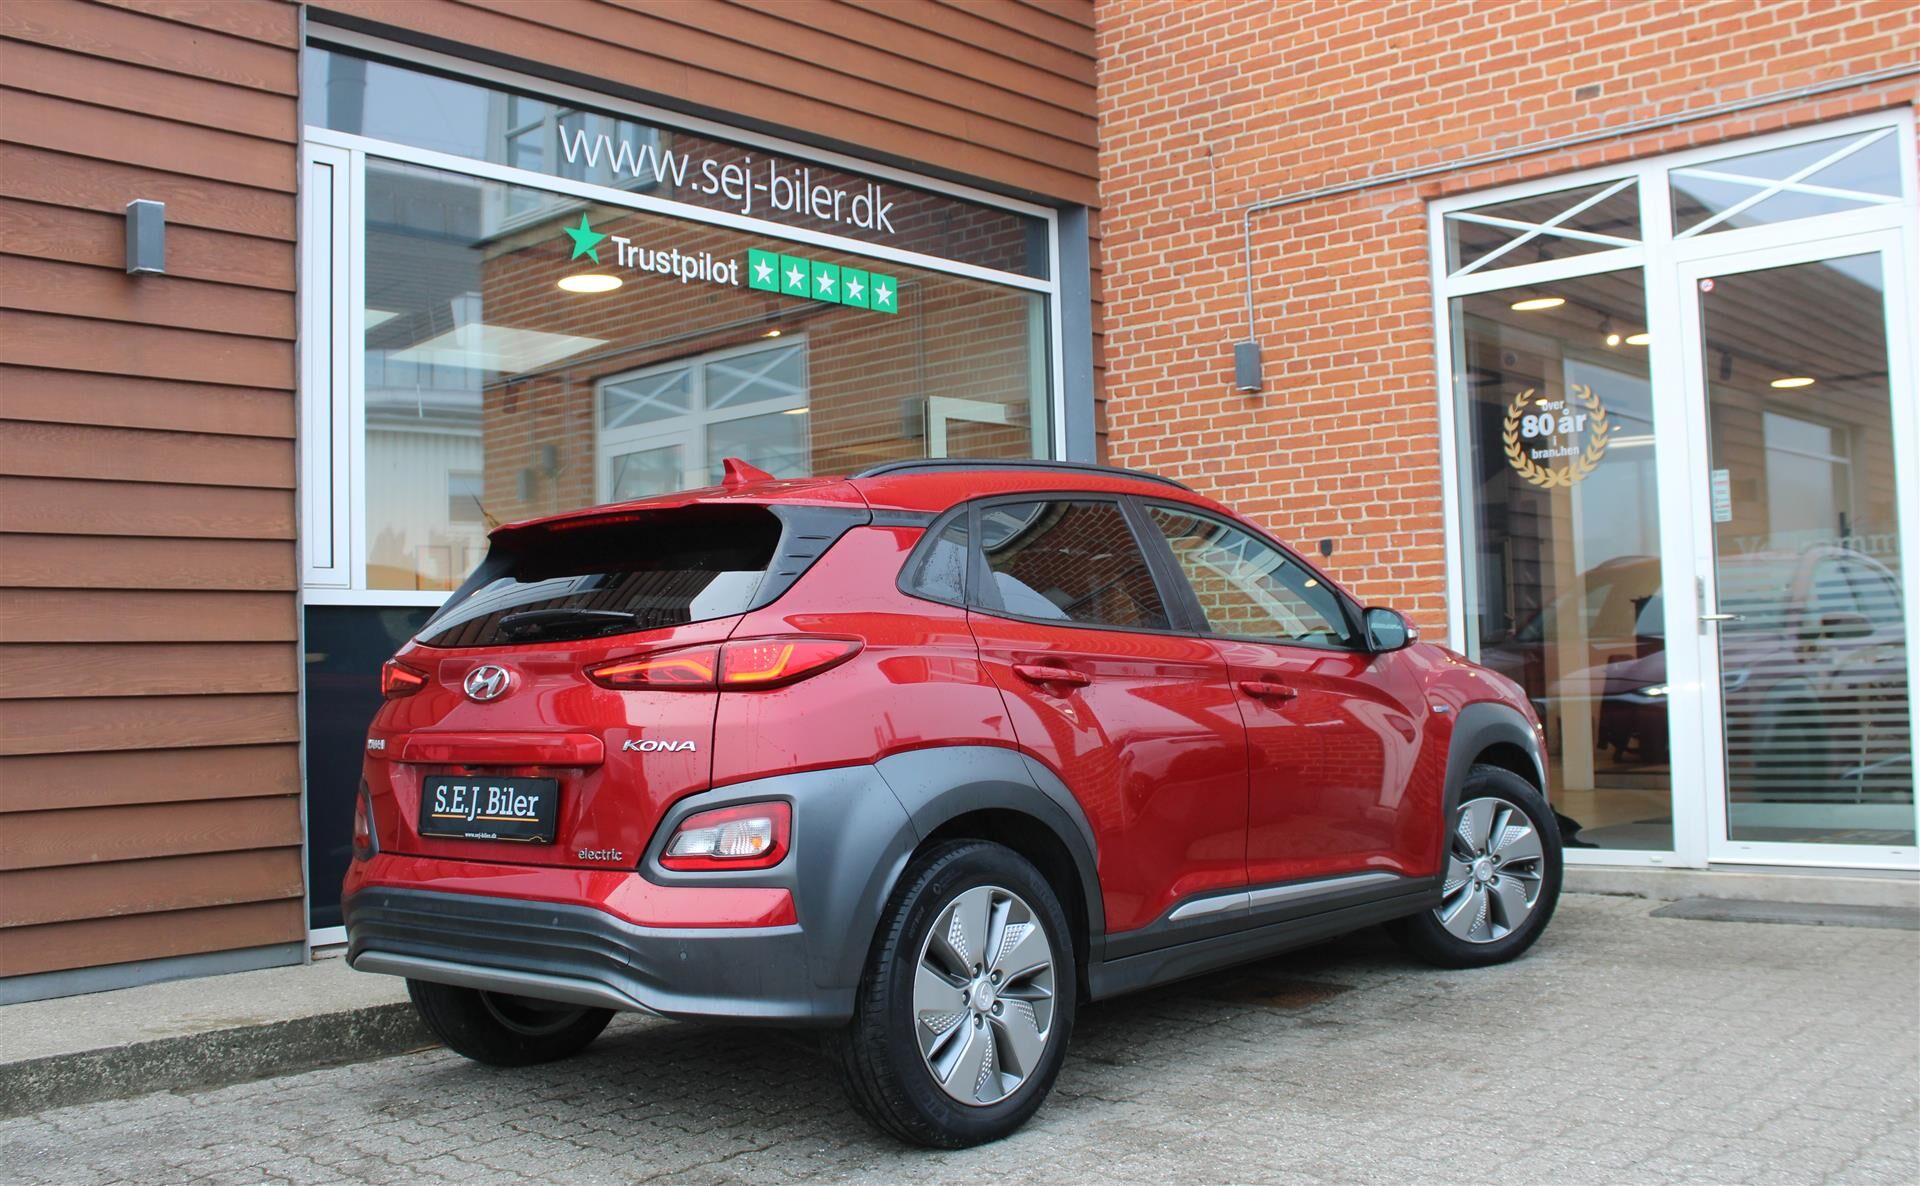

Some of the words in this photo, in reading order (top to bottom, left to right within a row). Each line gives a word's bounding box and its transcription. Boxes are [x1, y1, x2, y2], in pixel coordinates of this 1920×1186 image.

[558, 124, 896, 233] www.sej-biler.dk
[611, 235, 739, 287] Trustpilot
[1541, 401, 1564, 412] over
[1522, 413, 1555, 438] 80
[1558, 408, 1587, 434] år
[622, 739, 697, 752] KONA
[434, 784, 482, 822] S.E.J.
[486, 786, 540, 817] Biler
[578, 847, 623, 861] electric
